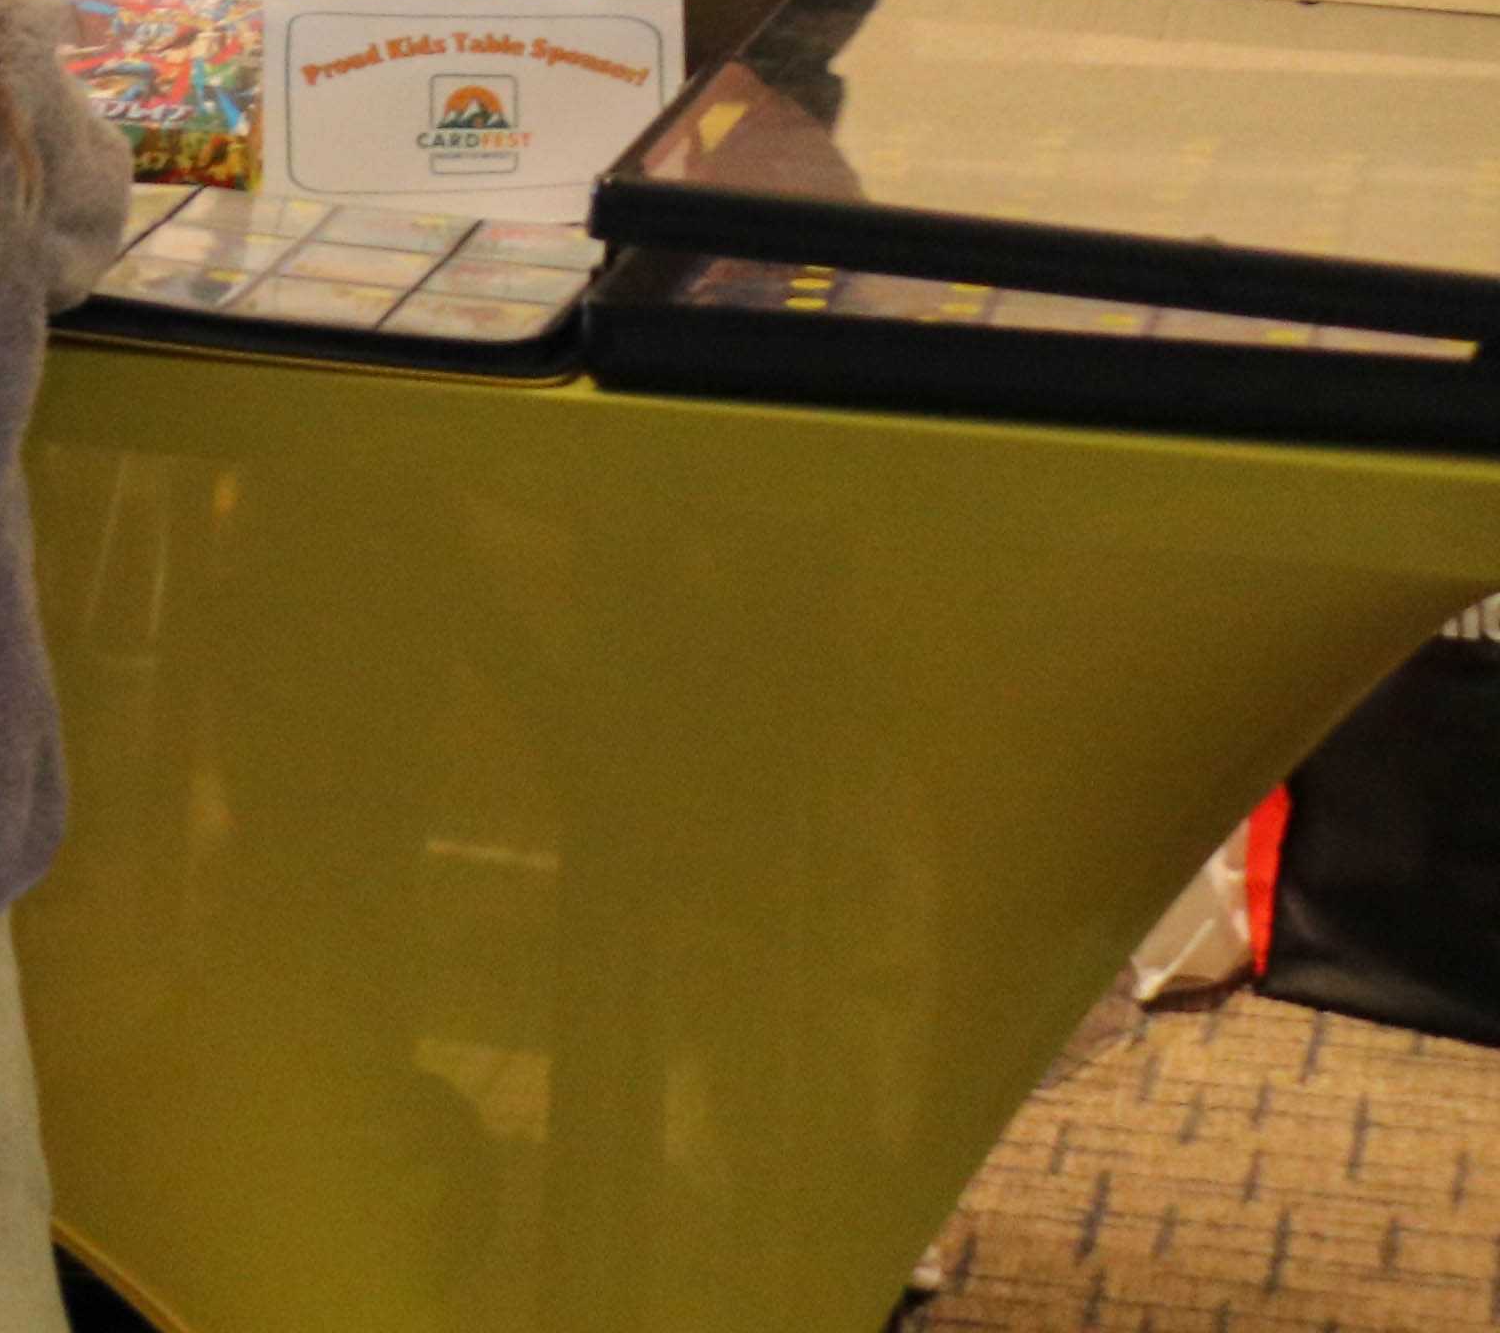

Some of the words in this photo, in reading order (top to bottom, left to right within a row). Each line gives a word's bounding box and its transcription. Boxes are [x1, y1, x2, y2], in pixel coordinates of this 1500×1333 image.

[302, 44, 383, 85] Proud
[385, 35, 446, 60] Kids
[452, 32, 525, 55] Table
[530, 38, 650, 86] Sponsor!
[416, 131, 532, 150] CARDFEST
